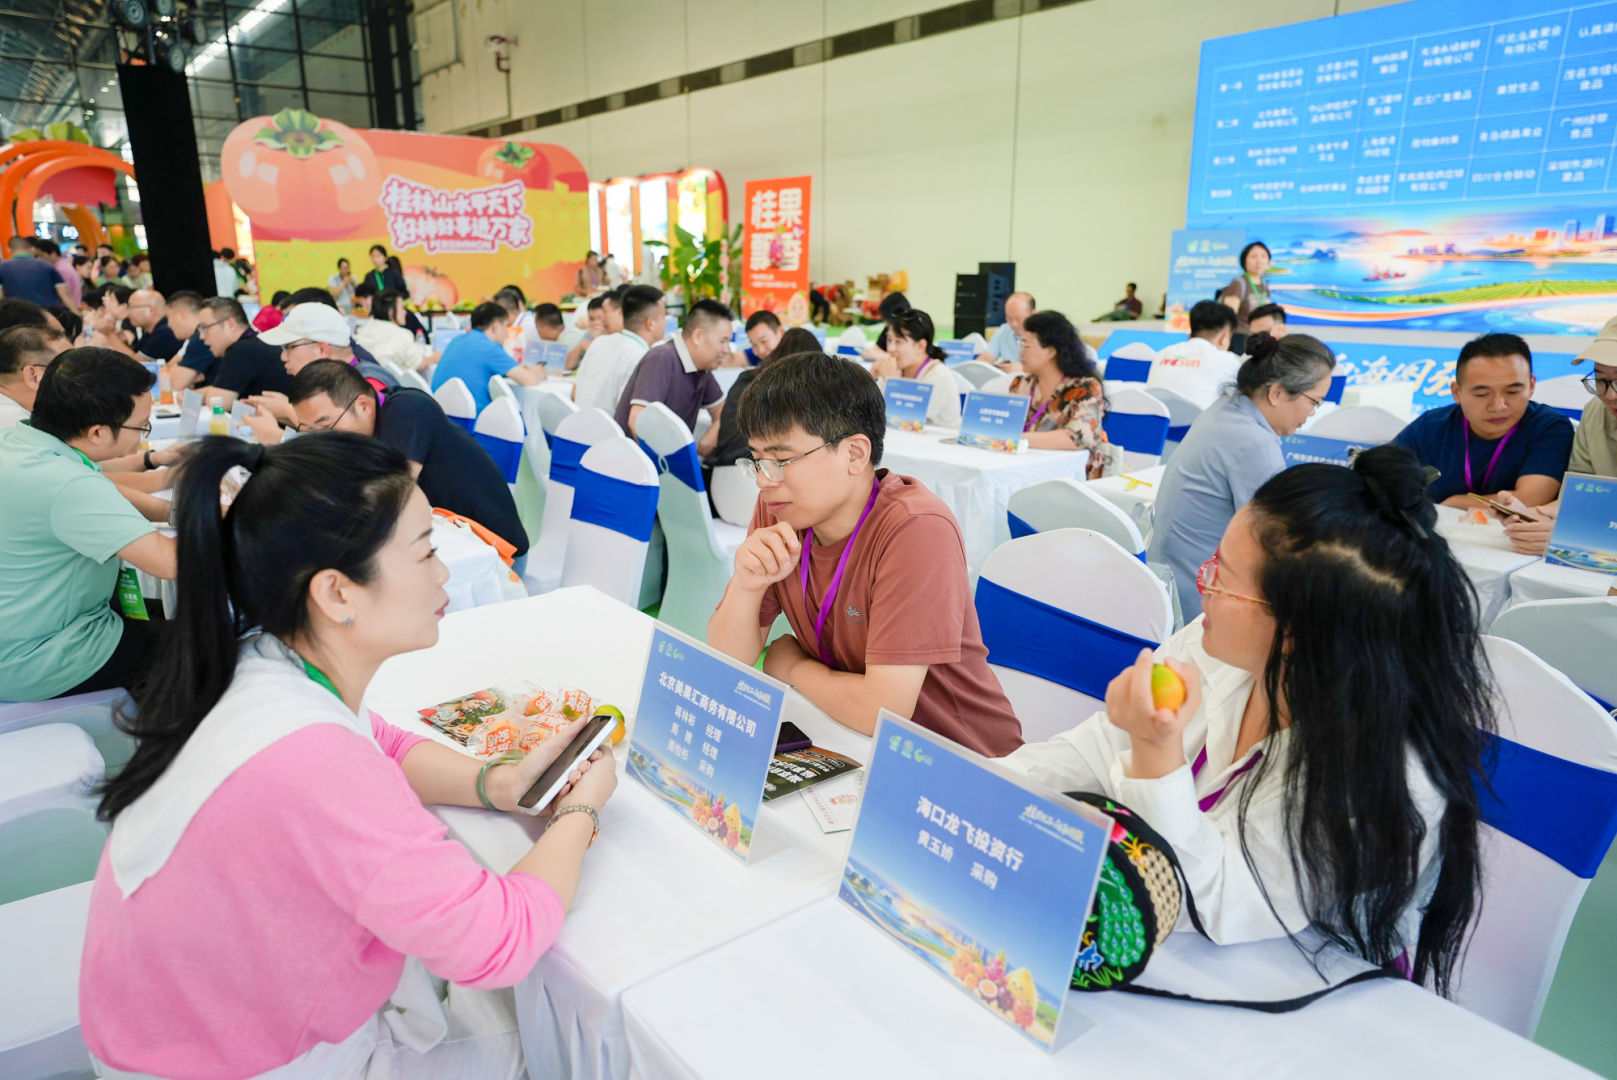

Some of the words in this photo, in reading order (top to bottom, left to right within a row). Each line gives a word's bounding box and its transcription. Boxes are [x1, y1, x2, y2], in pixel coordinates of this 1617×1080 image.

[384, 179, 523, 214] 桂林山水甲天下
[751, 188, 803, 230] 桂果
[658, 671, 757, 738] 北京美果汇商务有限公司
[916, 796, 1024, 871] 海口龙飞投资行
[969, 861, 998, 890] 采购
